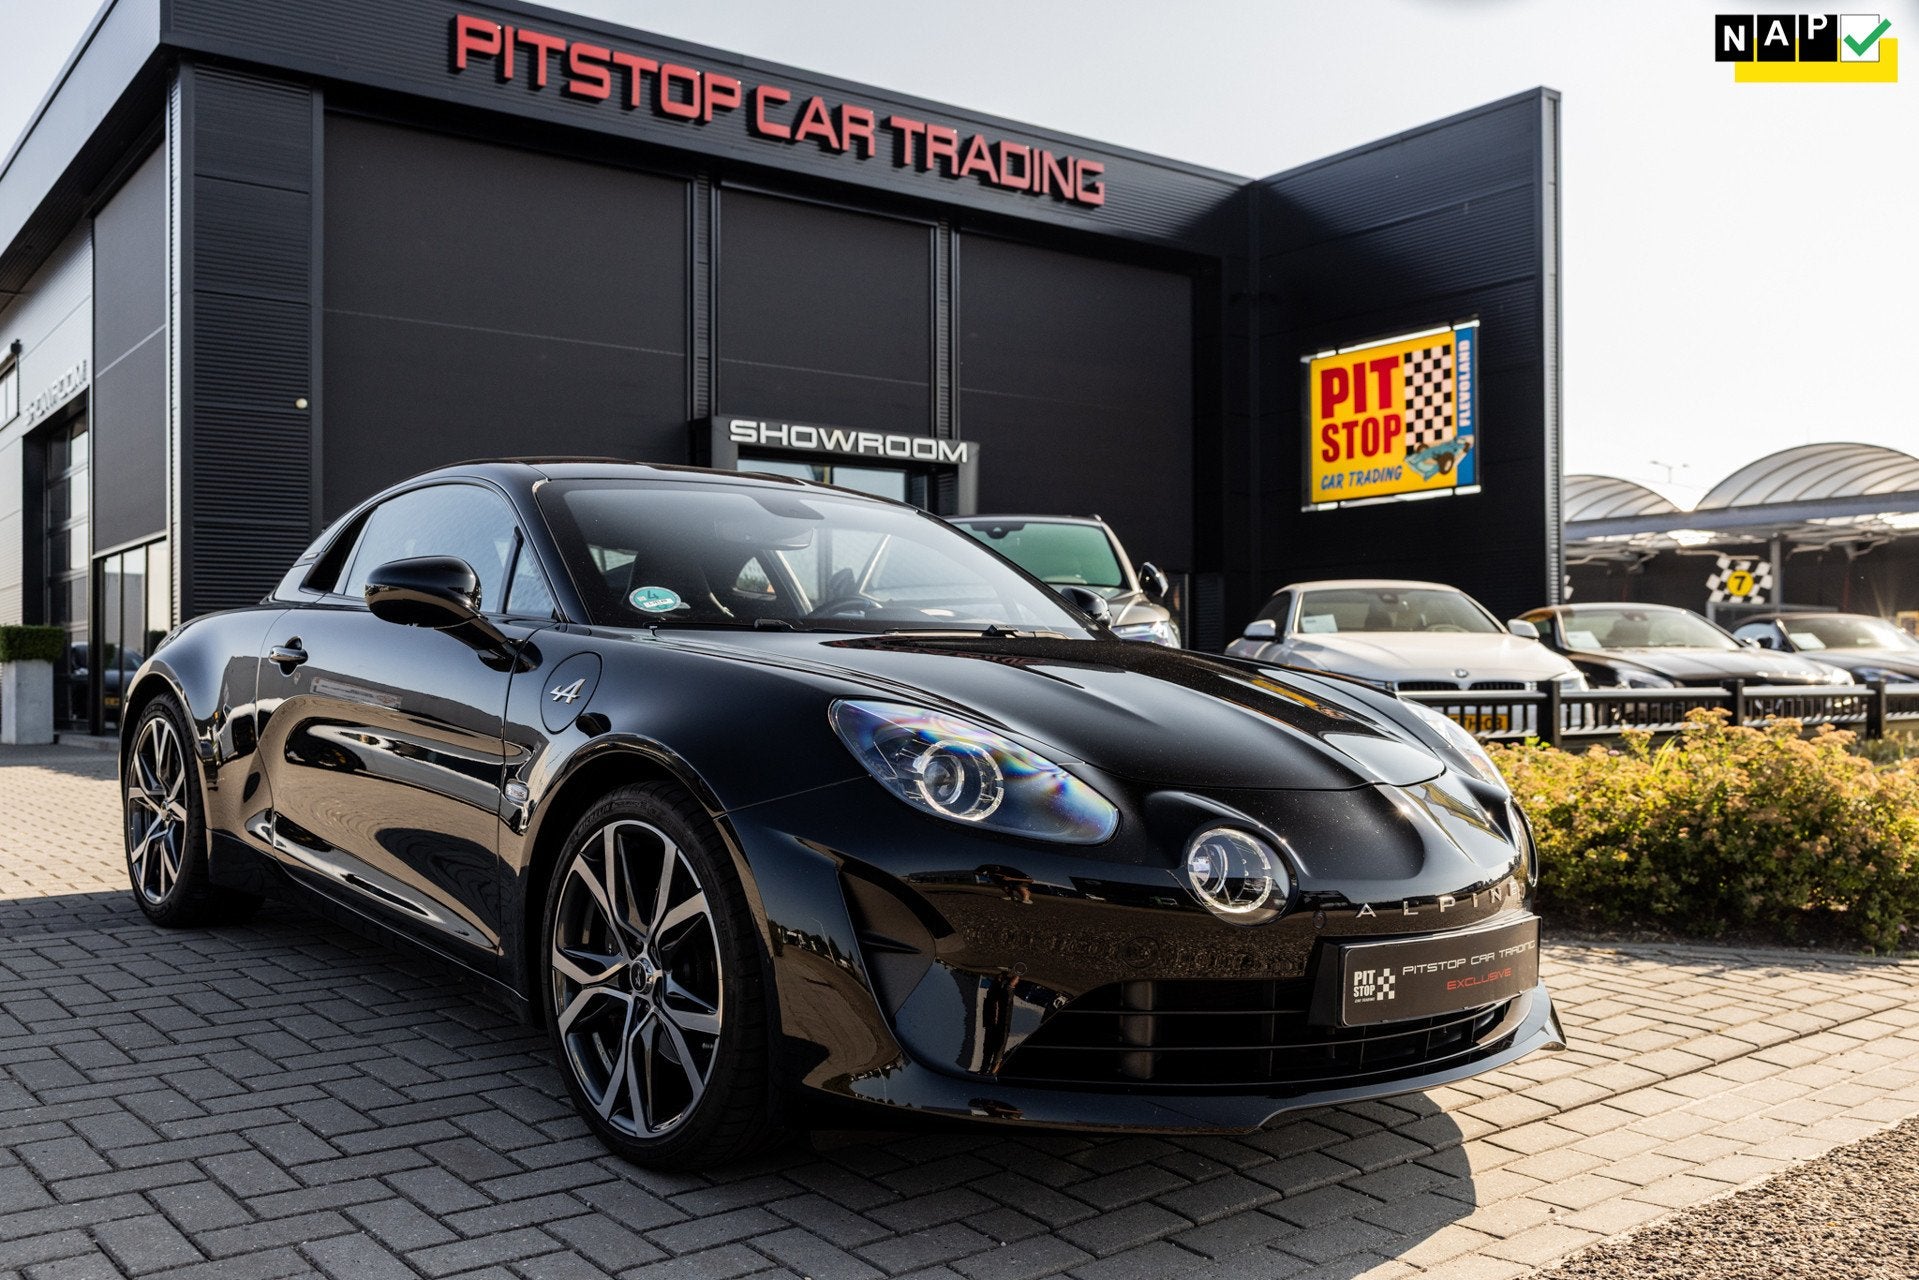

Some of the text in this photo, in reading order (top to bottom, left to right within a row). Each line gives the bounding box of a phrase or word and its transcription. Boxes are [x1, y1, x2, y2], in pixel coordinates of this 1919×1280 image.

[457, 14, 1104, 205] PITSTOP CAR TRADING
[1321, 356, 1400, 420] PIT
[1458, 340, 1471, 427] FLEVOLAND
[729, 420, 968, 463] SHOWROOM
[1321, 414, 1401, 463] STOP
[1321, 465, 1402, 490] CAR TRADING
[1734, 575, 1746, 592] 7
[1356, 881, 1519, 919] ALPINE
[1402, 940, 1535, 976] PITSTOP CAR TRADING
[1353, 984, 1376, 998] STOP
[1354, 969, 1376, 986] PIT
[1446, 967, 1512, 990] EXCLUSIVE
